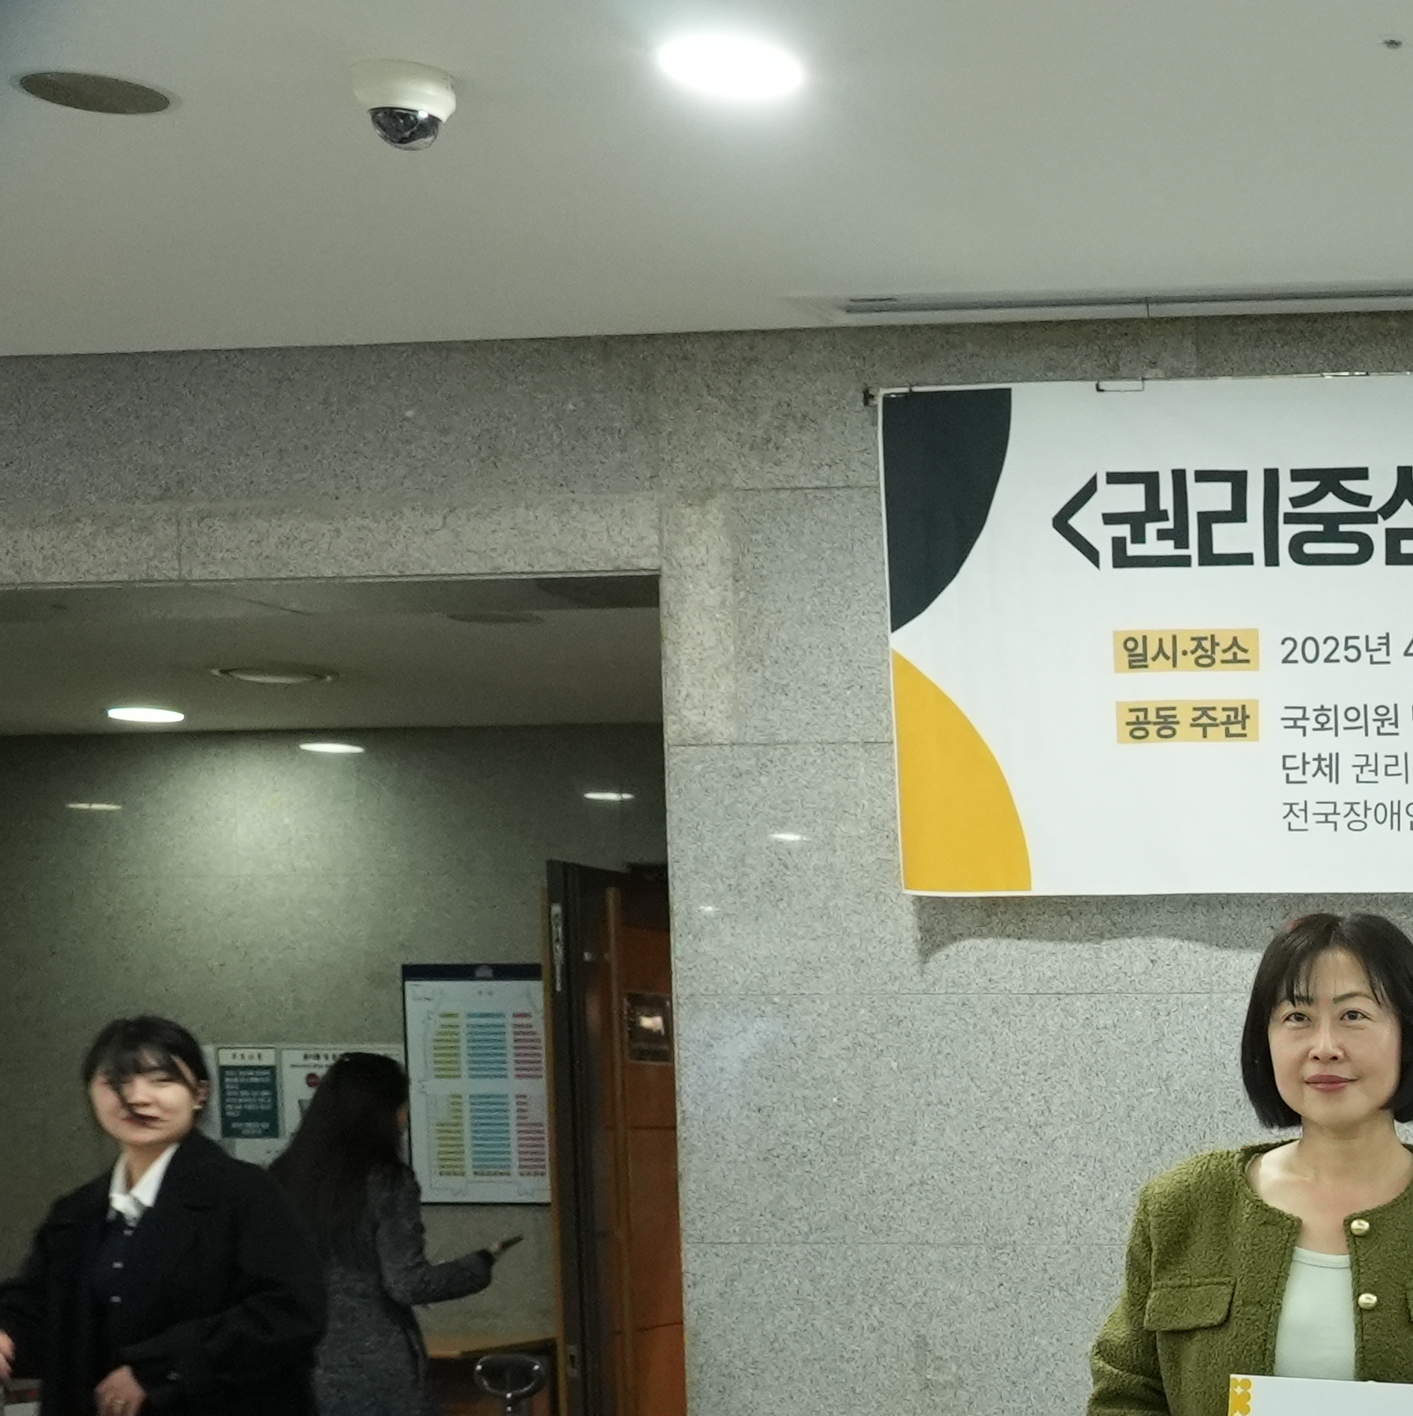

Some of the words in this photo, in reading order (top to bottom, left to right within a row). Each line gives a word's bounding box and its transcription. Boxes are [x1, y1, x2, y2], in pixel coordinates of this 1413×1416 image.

[1122, 634, 1251, 668] 일시·장소
[1281, 632, 1390, 664] 2025년
[1125, 705, 1180, 739] 공동
[1189, 705, 1249, 738] 주관
[1281, 704, 1399, 737] 국회의원
[1282, 752, 1339, 784] 단체
